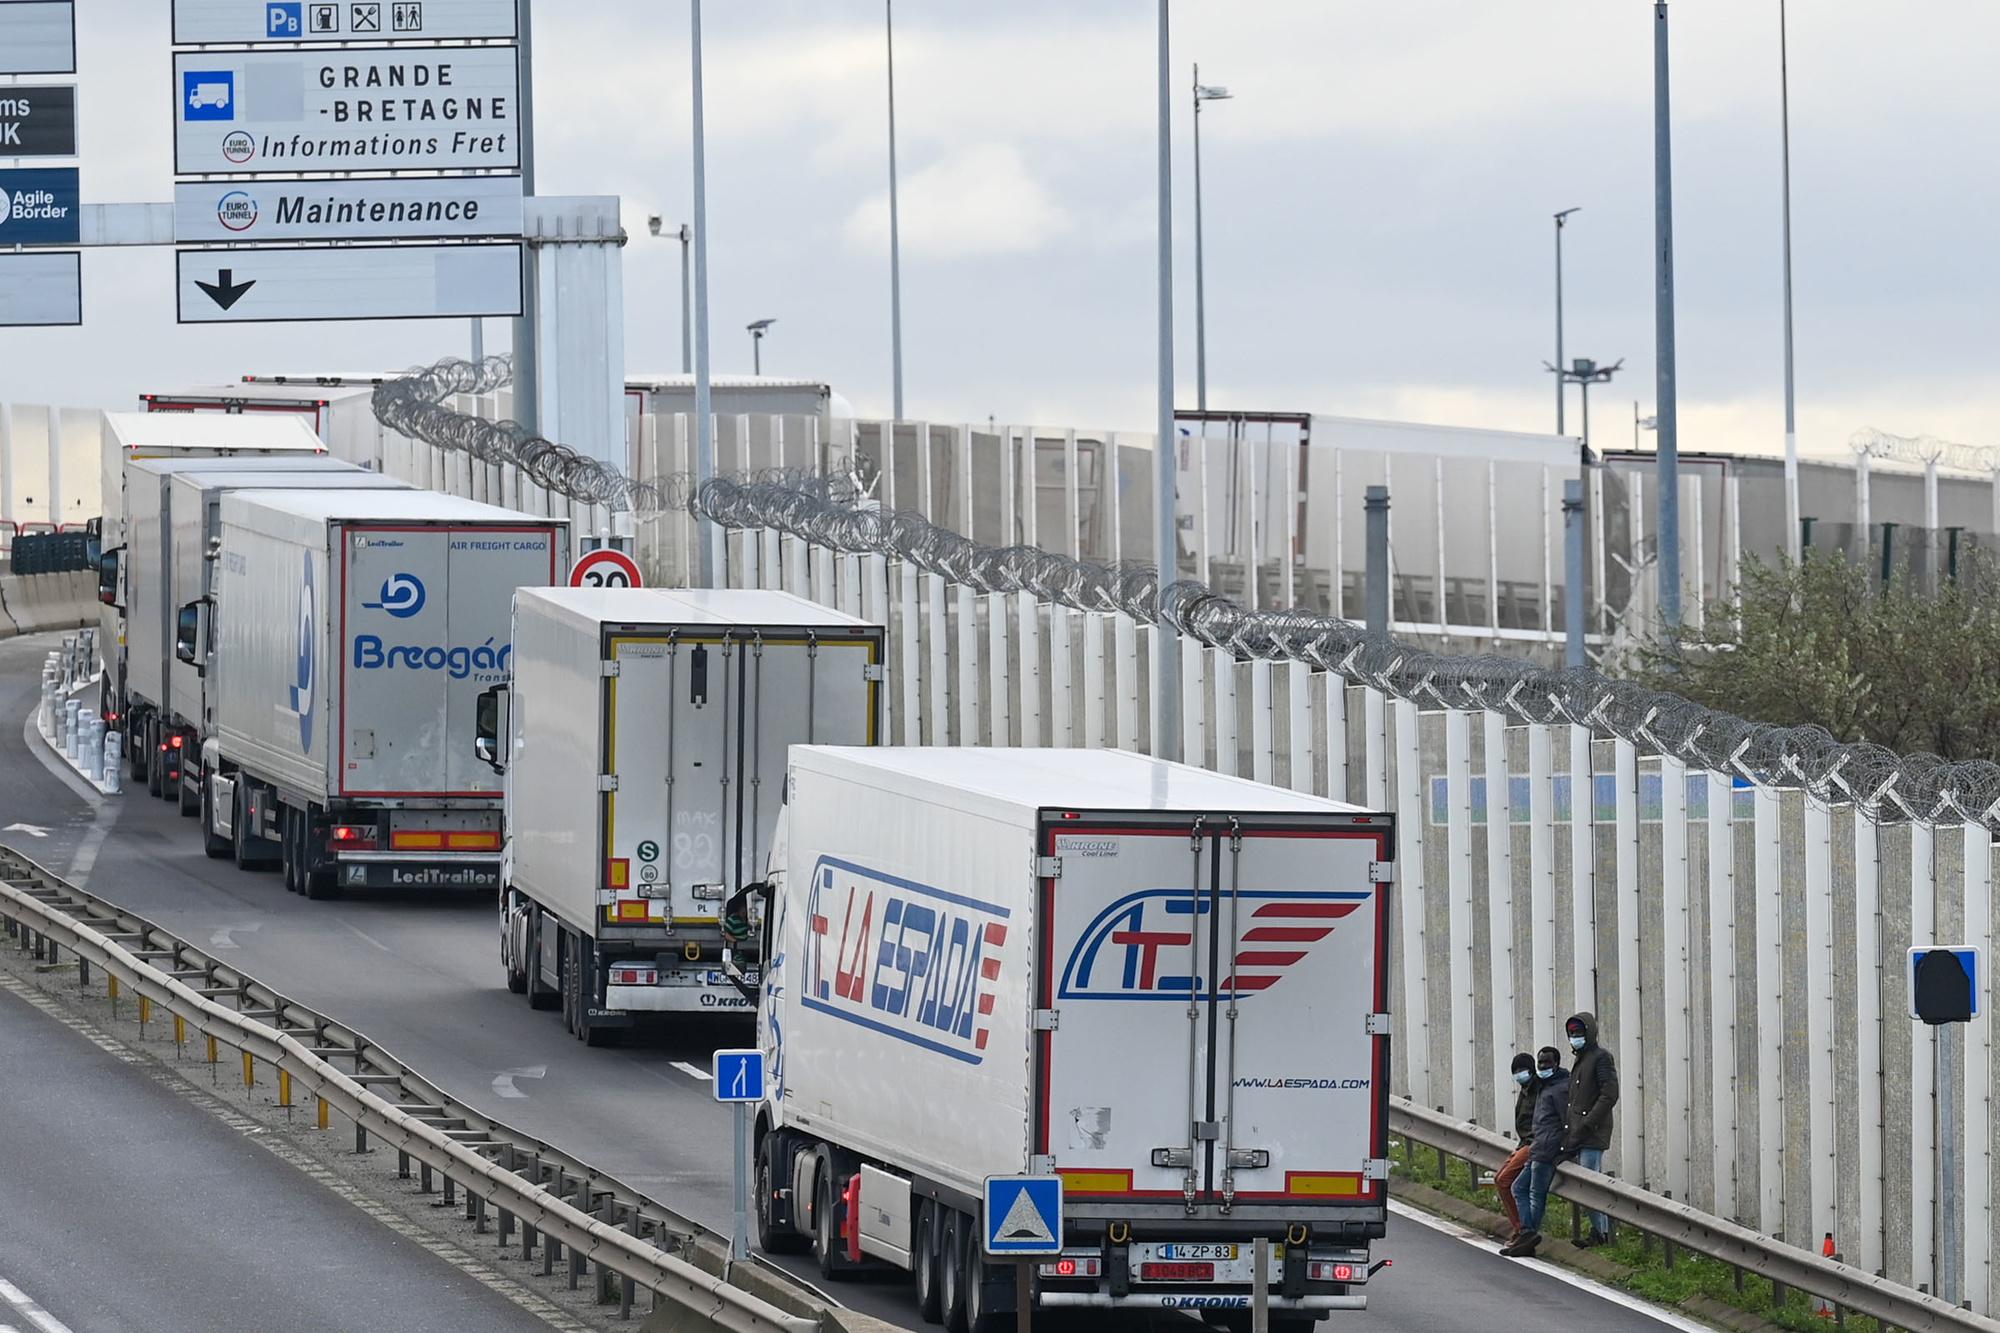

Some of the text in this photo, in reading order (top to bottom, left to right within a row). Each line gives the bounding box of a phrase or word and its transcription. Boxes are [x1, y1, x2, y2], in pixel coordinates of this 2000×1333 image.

[319, 64, 453, 88] GRANDE
[320, 97, 506, 122] -BRETAGNE
[226, 146, 251, 154] TUNNEL
[229, 139, 248, 147] EURO
[262, 132, 506, 157] Informations Fret
[13, 190, 54, 208] Agile
[12, 205, 68, 219] Border
[226, 202, 249, 211] EURO
[276, 197, 479, 224] Maintenance
[222, 211, 252, 220] TUNNEL
[450, 541, 546, 551] AIR FREIGHT CARGO
[393, 868, 496, 884] LeciTrailer
[697, 904, 708, 912] PL
[835, 886, 983, 1040] LA ESPADA
[1179, 1297, 1249, 1308] KRONE
